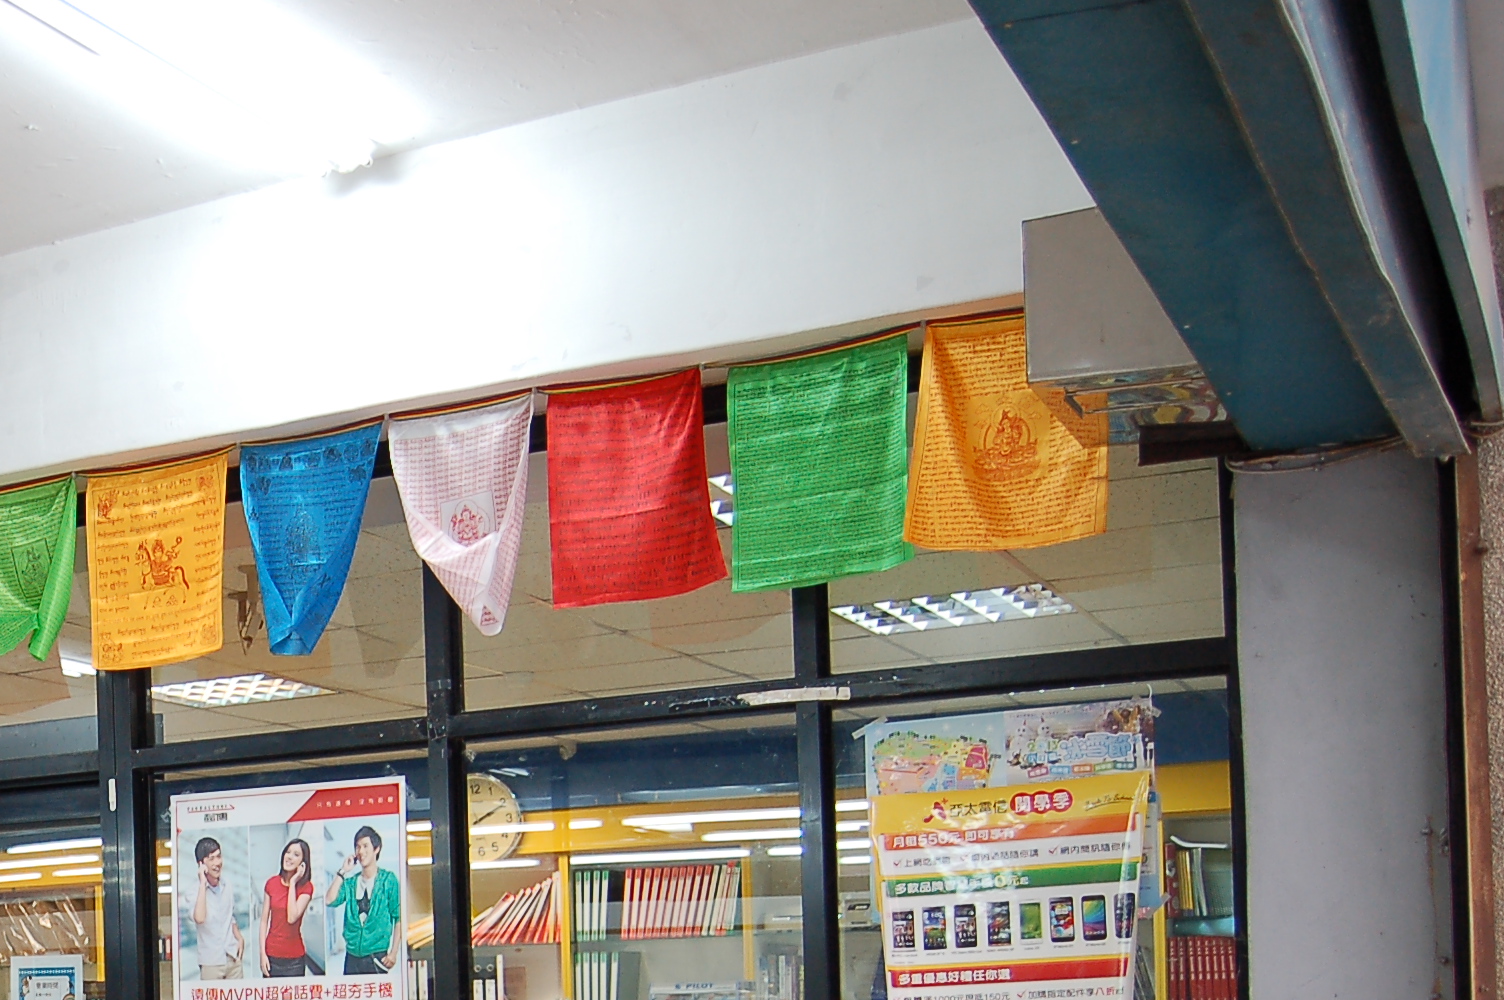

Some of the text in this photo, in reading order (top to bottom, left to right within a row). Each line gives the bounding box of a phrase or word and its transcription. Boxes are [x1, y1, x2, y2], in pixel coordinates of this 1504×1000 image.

[469, 785, 481, 794] 12
[488, 786, 493, 795] 1
[949, 801, 1008, 818] 亞太電信
[505, 813, 513, 823] 3
[478, 846, 486, 857] 6
[491, 841, 499, 852] 5
